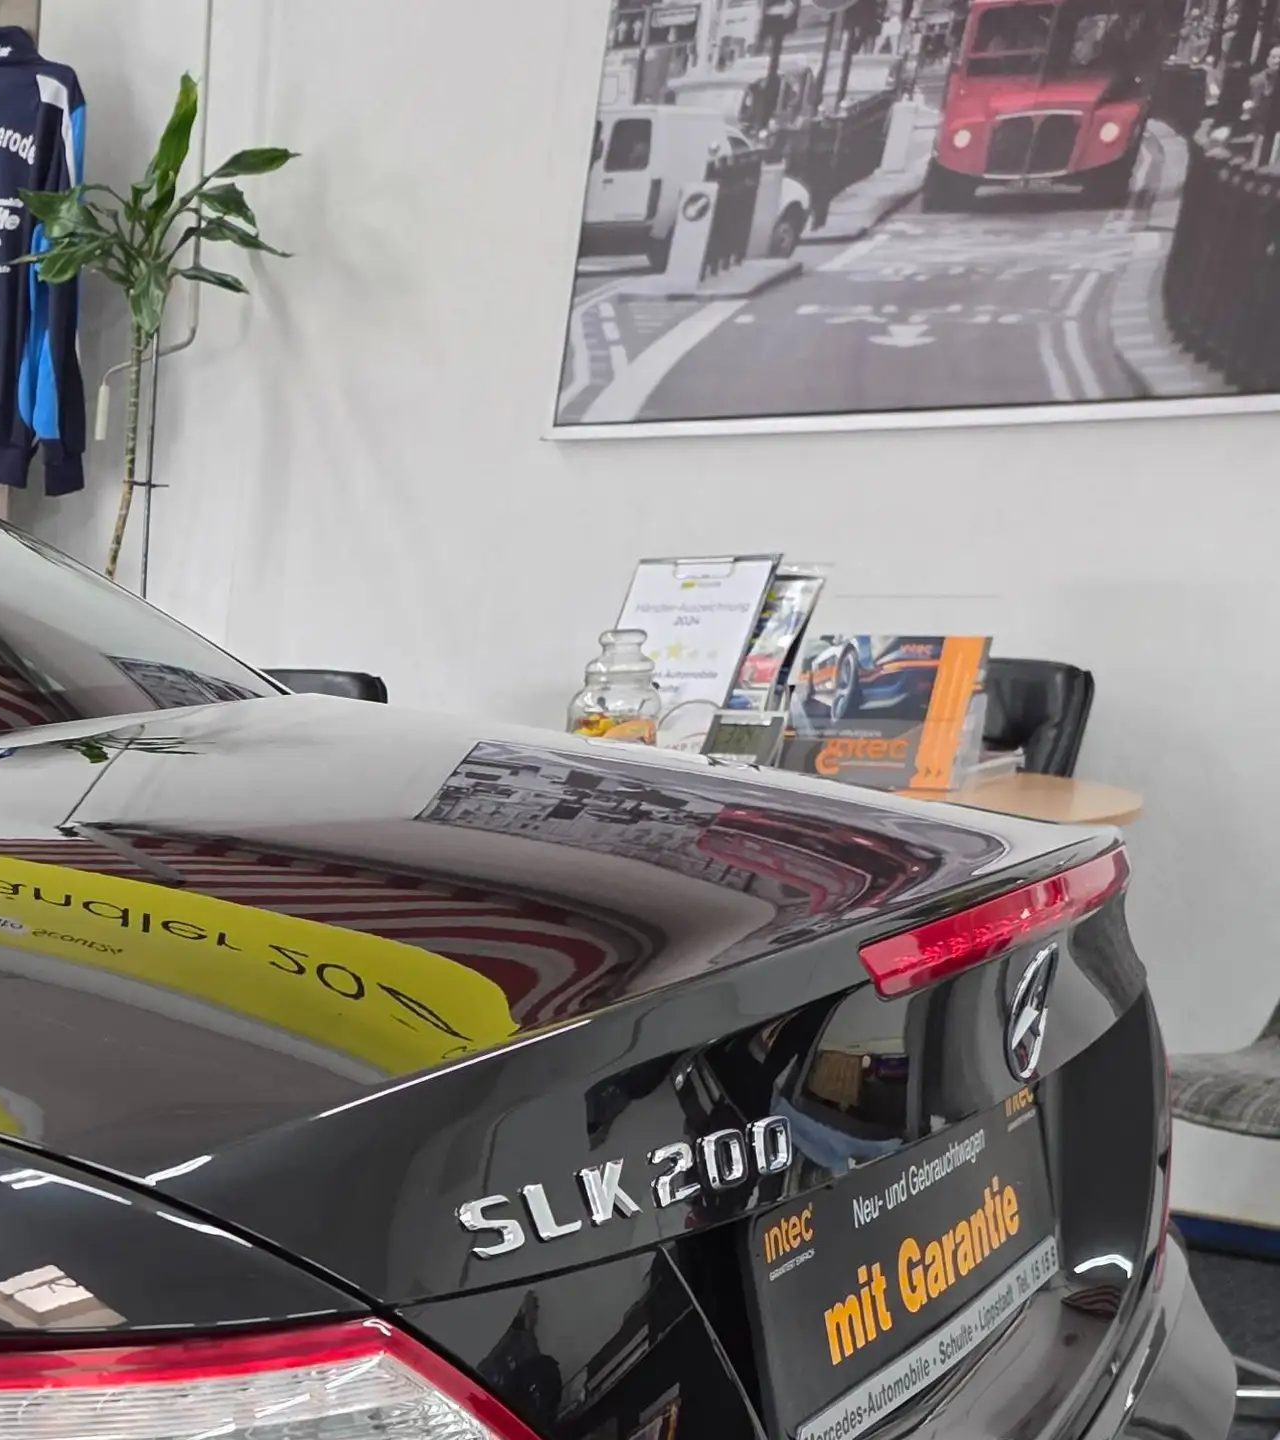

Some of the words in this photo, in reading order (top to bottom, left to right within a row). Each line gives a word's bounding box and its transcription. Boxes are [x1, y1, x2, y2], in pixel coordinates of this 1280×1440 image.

[455, 1155, 642, 1259] SLK
[646, 1114, 793, 1209] 200
[852, 1198, 883, 1228] Neu-
[885, 1172, 907, 1211] und
[908, 1128, 986, 1197] Gebrauchtwagen
[824, 1261, 892, 1367] mit
[897, 1174, 1020, 1314] Garantie
[938, 1323, 974, 1366] Schulte
[978, 1281, 1014, 1334] Lippstadt
